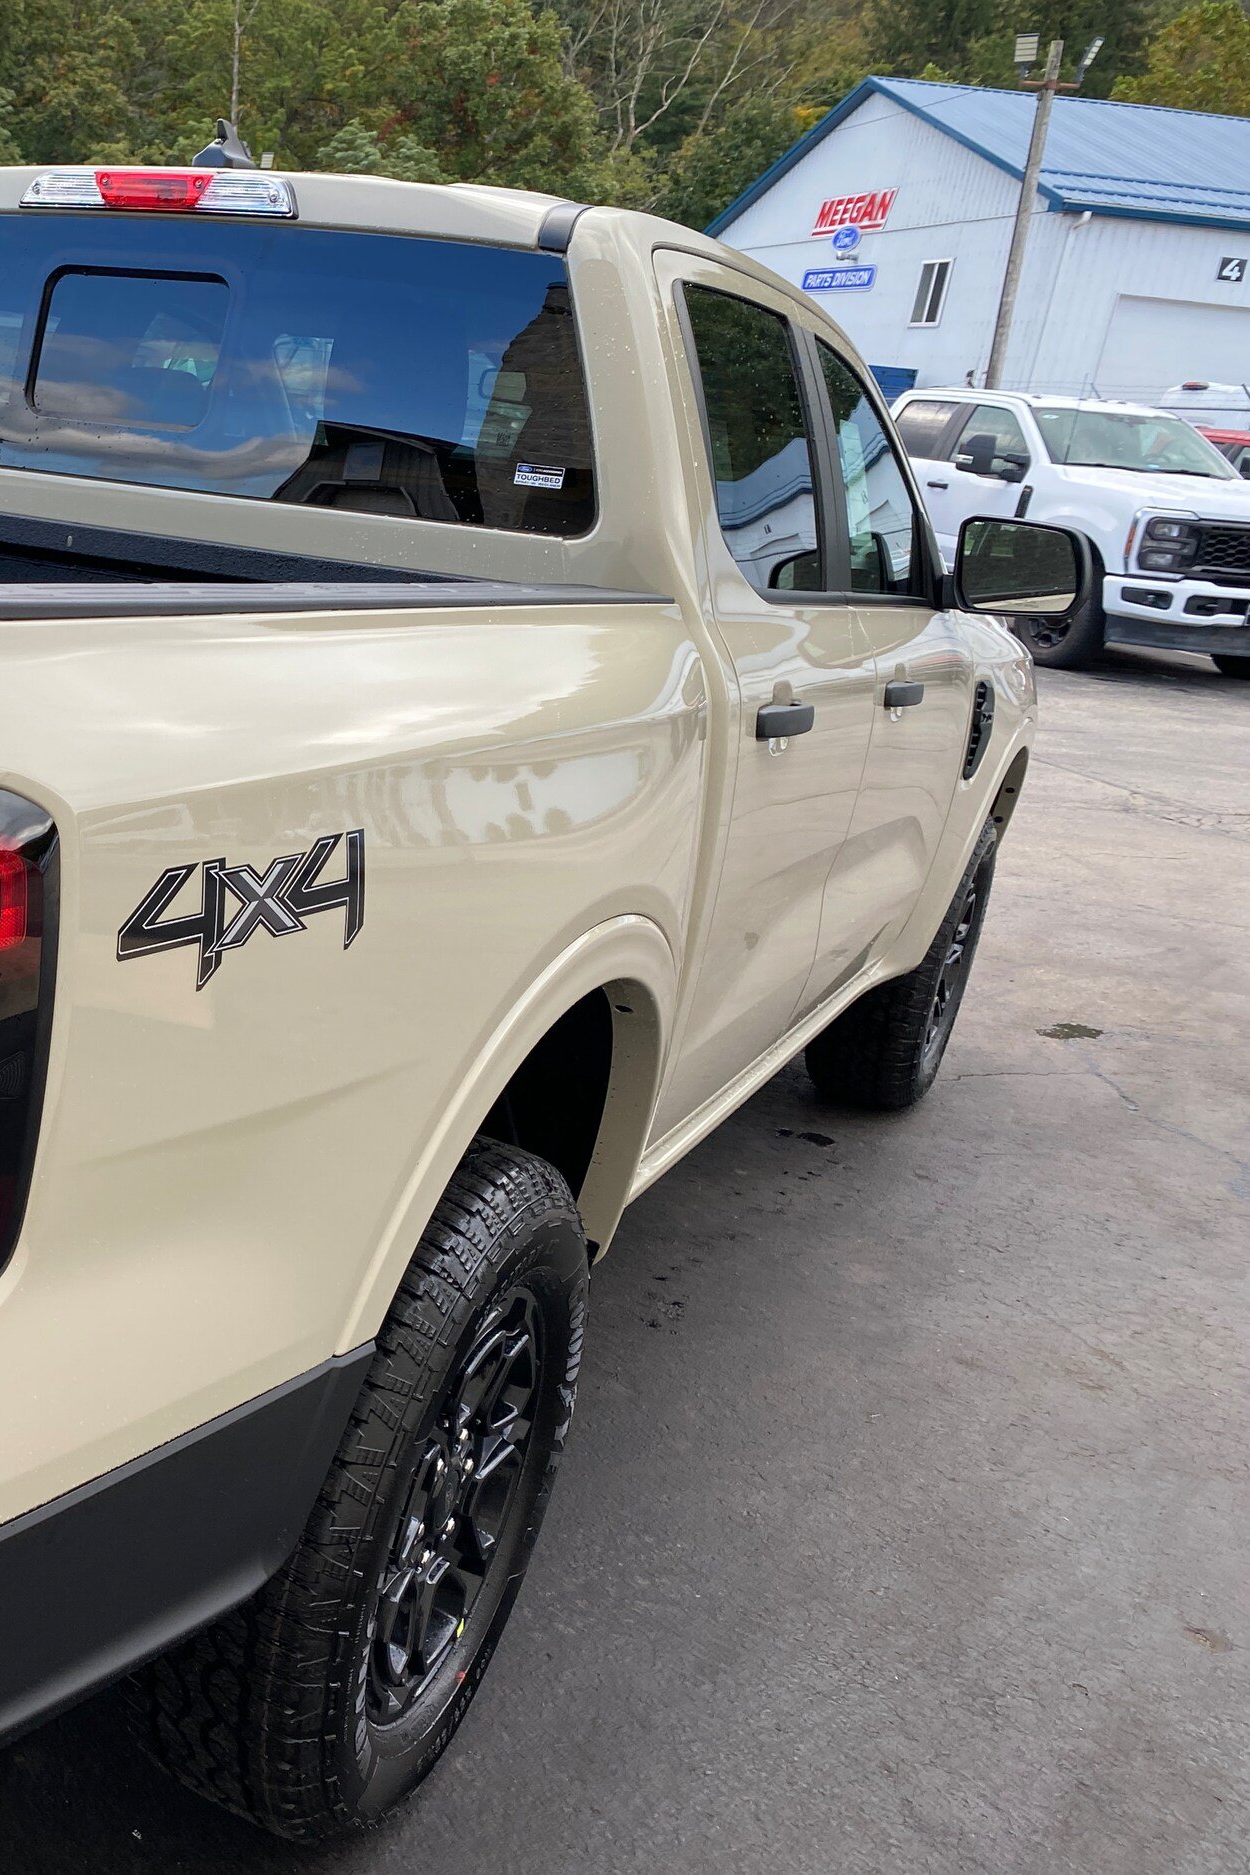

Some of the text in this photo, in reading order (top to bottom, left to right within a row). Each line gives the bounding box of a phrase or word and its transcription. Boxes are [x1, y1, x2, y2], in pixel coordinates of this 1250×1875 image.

[814, 190, 895, 229] MEEGAN
[804, 270, 872, 288] PARTS DIVISION
[1222, 260, 1240, 280] 4
[516, 473, 561, 484] TOUGHBED
